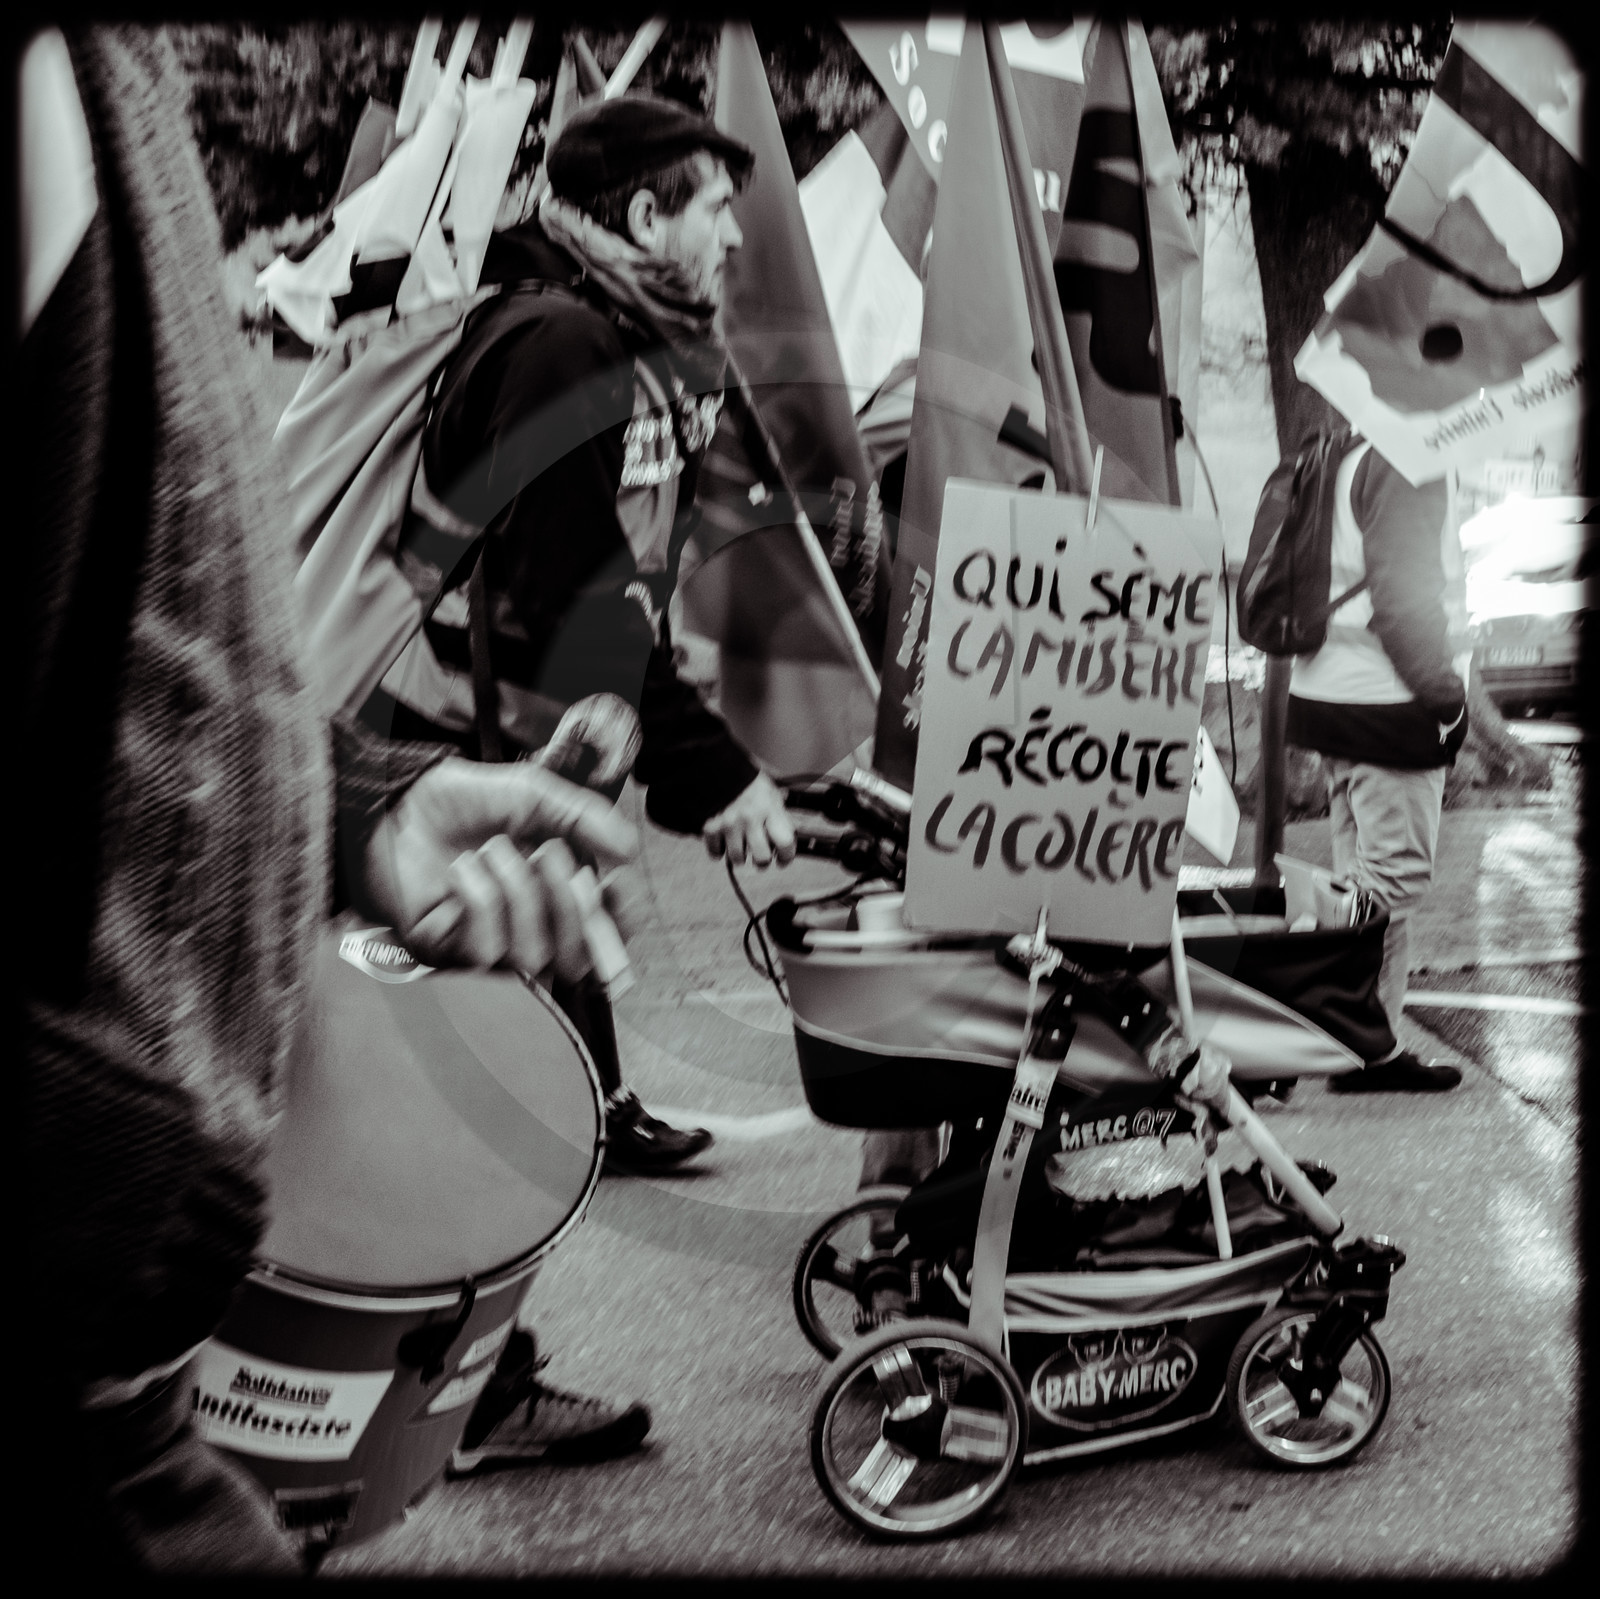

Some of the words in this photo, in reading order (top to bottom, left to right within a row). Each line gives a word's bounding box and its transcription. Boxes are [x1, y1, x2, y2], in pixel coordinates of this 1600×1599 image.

[947, 617, 1015, 700] LA
[957, 706, 1189, 797] RÉCOLTE
[924, 793, 996, 868] LA
